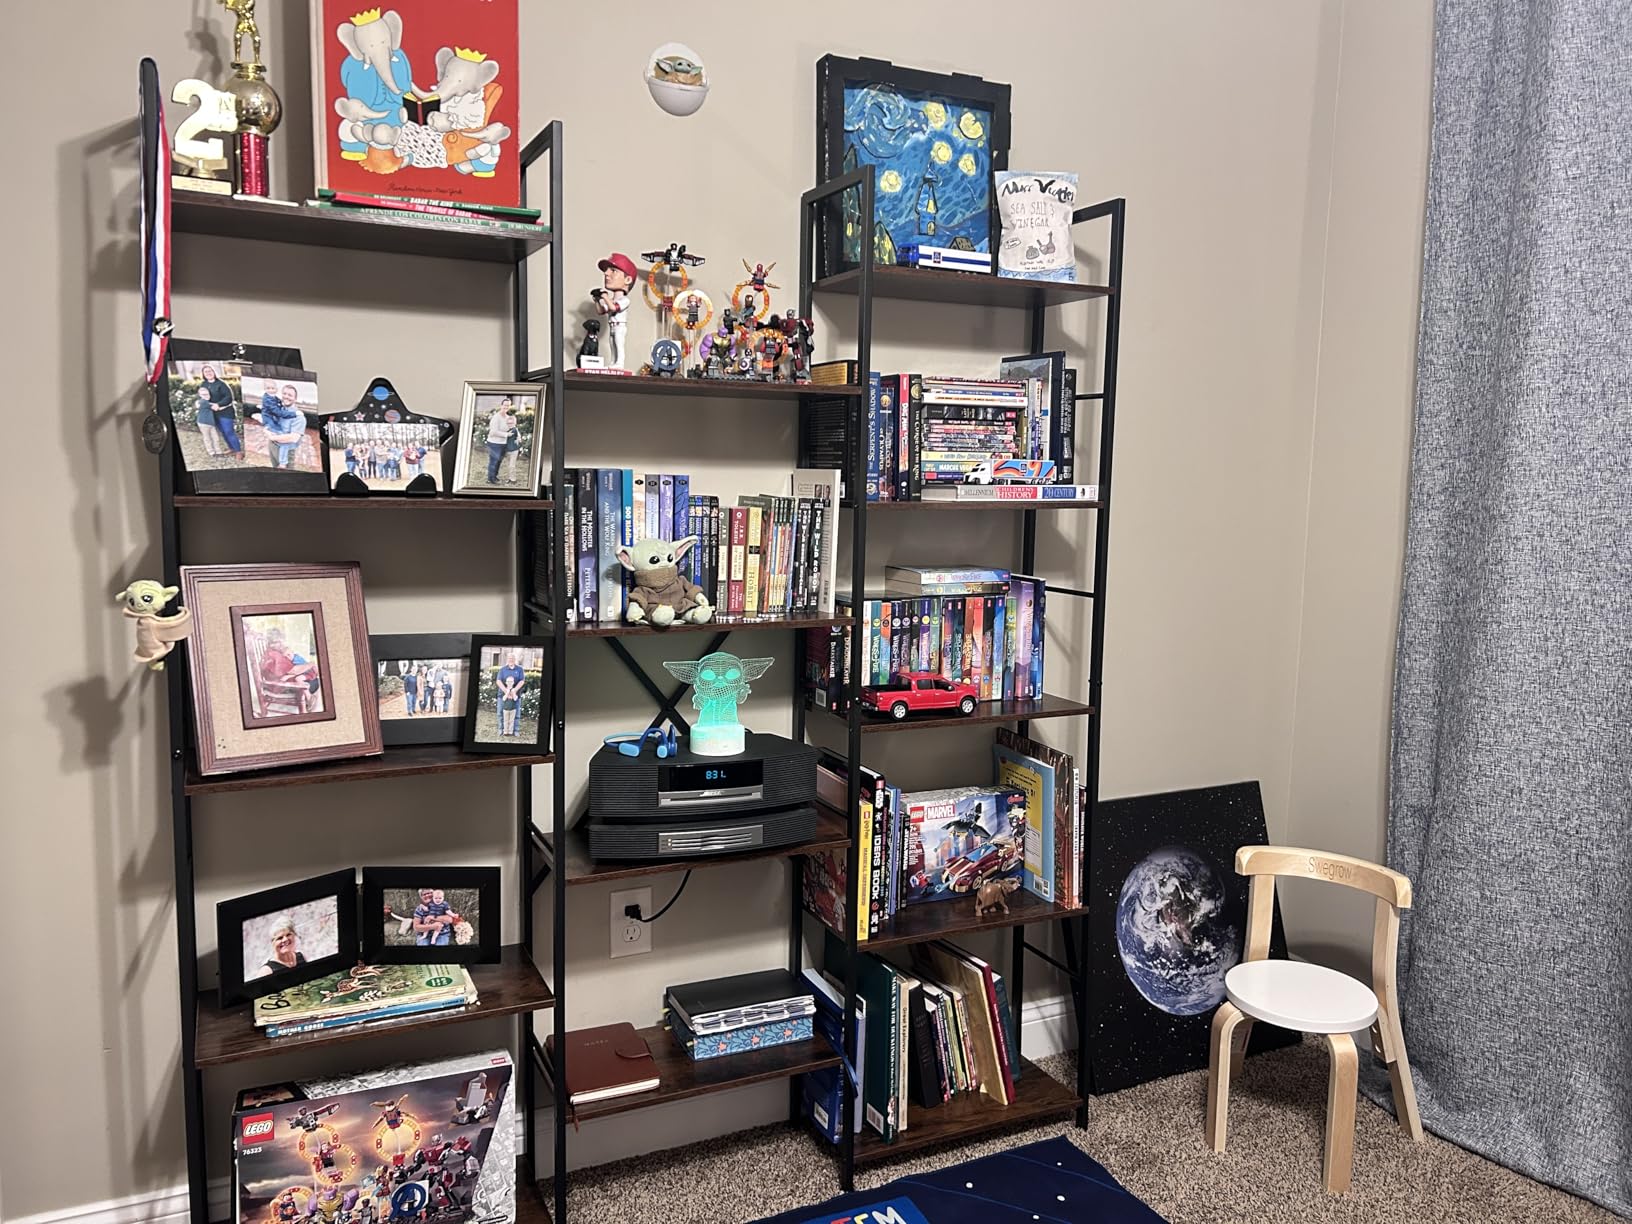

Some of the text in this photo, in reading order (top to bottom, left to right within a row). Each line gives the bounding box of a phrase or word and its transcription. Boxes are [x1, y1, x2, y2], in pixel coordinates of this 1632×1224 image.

[1010, 202, 1026, 215] SEA
[1031, 201, 1047, 215] SALT
[1010, 217, 1049, 229] VINEGAR
[868, 388, 876, 419] SHADOW
[867, 421, 876, 461] SERPENT'S
[996, 491, 1032, 499] HISTORY
[584, 568, 592, 599] PETERSON
[927, 804, 955, 820] MARVEL
[872, 834, 882, 900] IDEAS BOOK
[1308, 856, 1353, 881] Swegrow
[244, 1121, 273, 1136] LEGO
[242, 1147, 263, 1156] 76323
